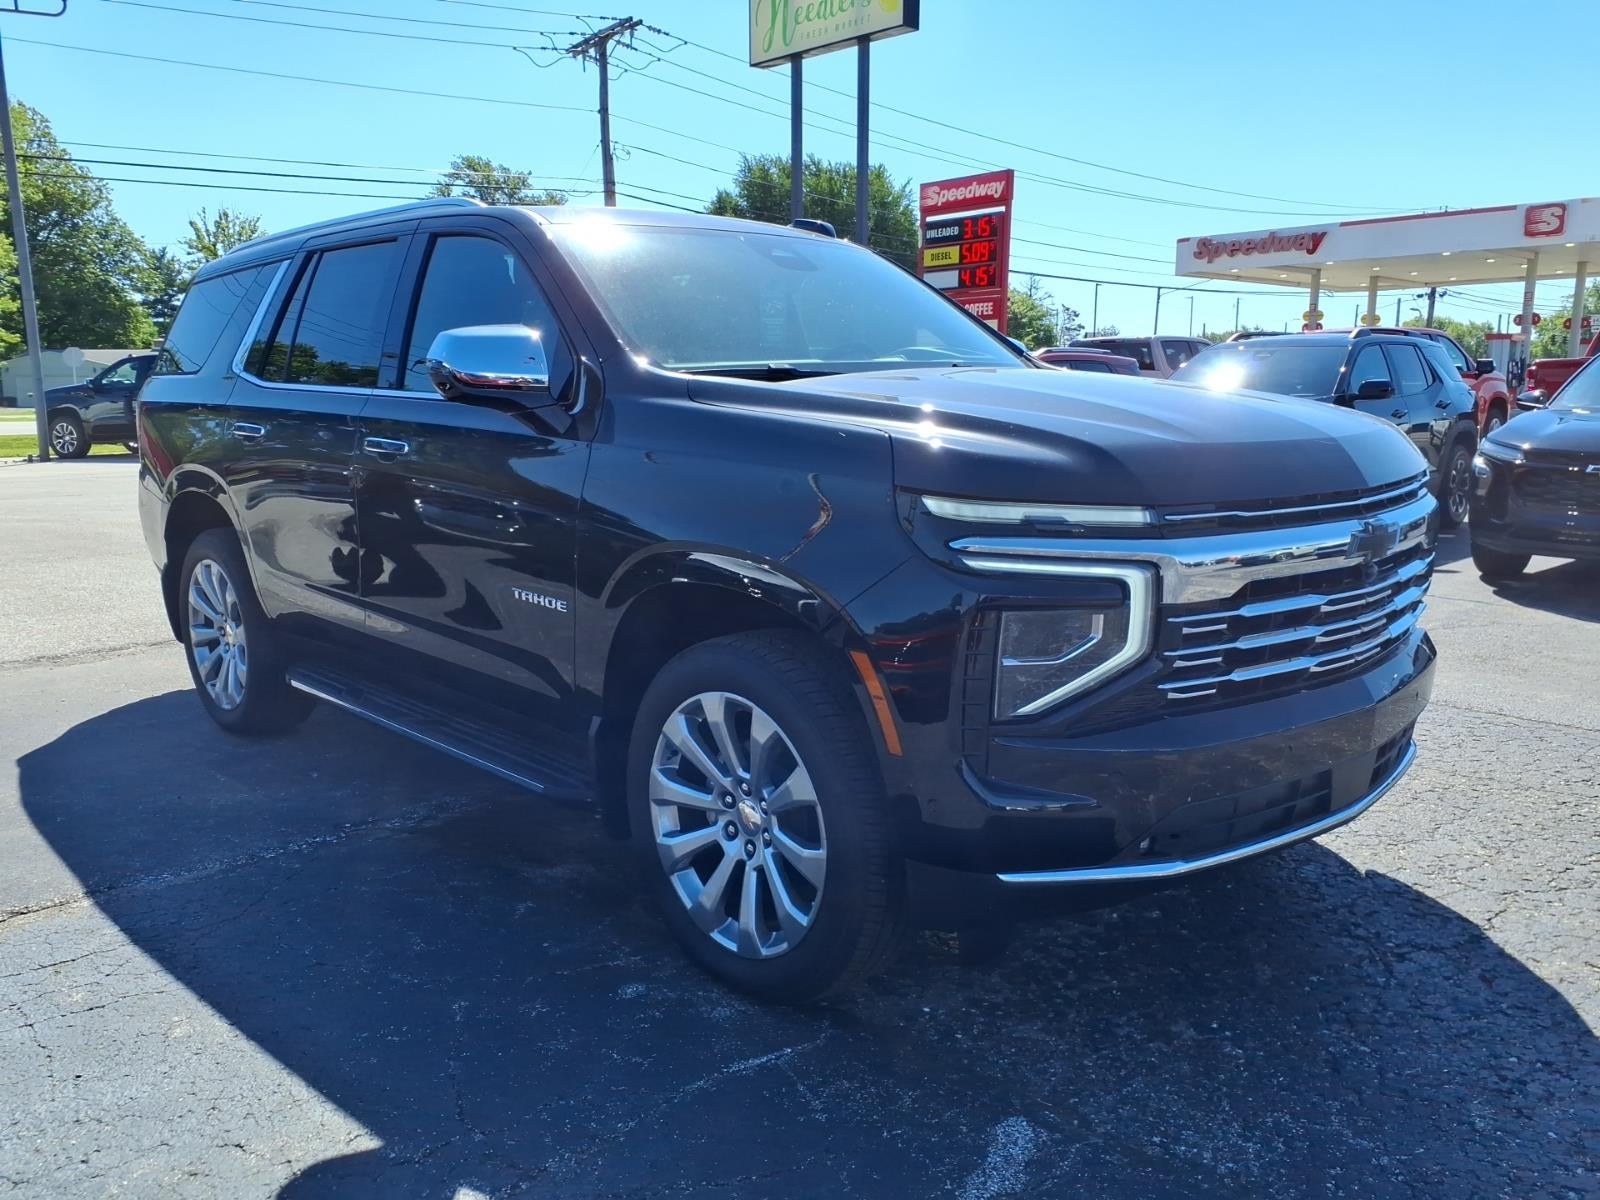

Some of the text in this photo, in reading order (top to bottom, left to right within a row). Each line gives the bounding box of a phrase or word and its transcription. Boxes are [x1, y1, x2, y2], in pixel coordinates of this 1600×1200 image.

[800, 14, 871, 40] FRESH MARKET
[922, 181, 1006, 206] Speedway
[926, 226, 959, 239] UNLEADED
[930, 251, 952, 262] DIESEL
[1193, 231, 1328, 264] Speedway
[512, 587, 568, 612] TAHOE
